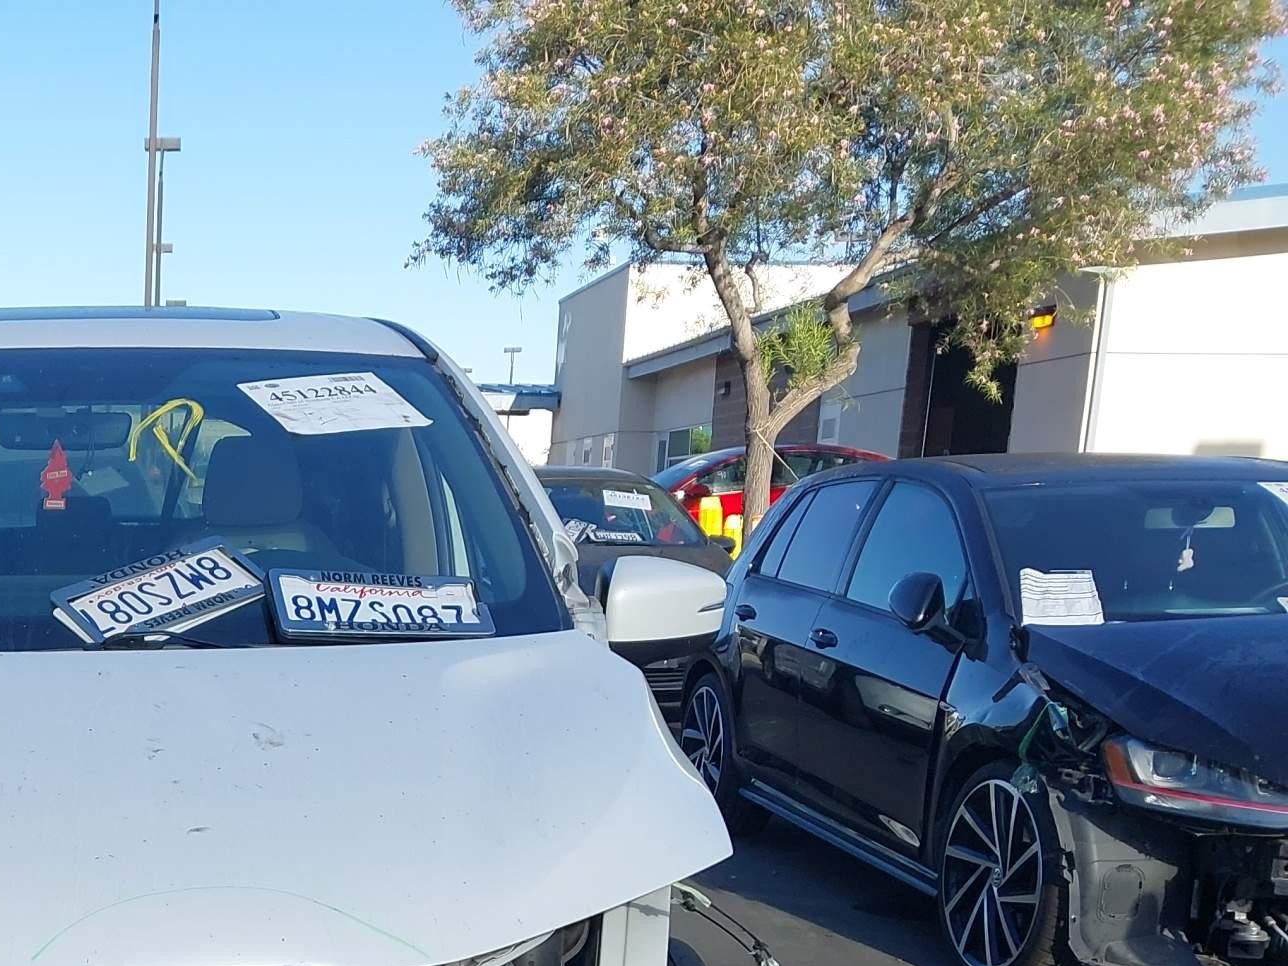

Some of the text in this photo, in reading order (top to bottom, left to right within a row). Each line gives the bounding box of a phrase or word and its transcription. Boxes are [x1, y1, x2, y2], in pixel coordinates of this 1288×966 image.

[270, 384, 376, 402] 45122844
[320, 571, 423, 587] NORM REEVES
[315, 583, 438, 599] California
